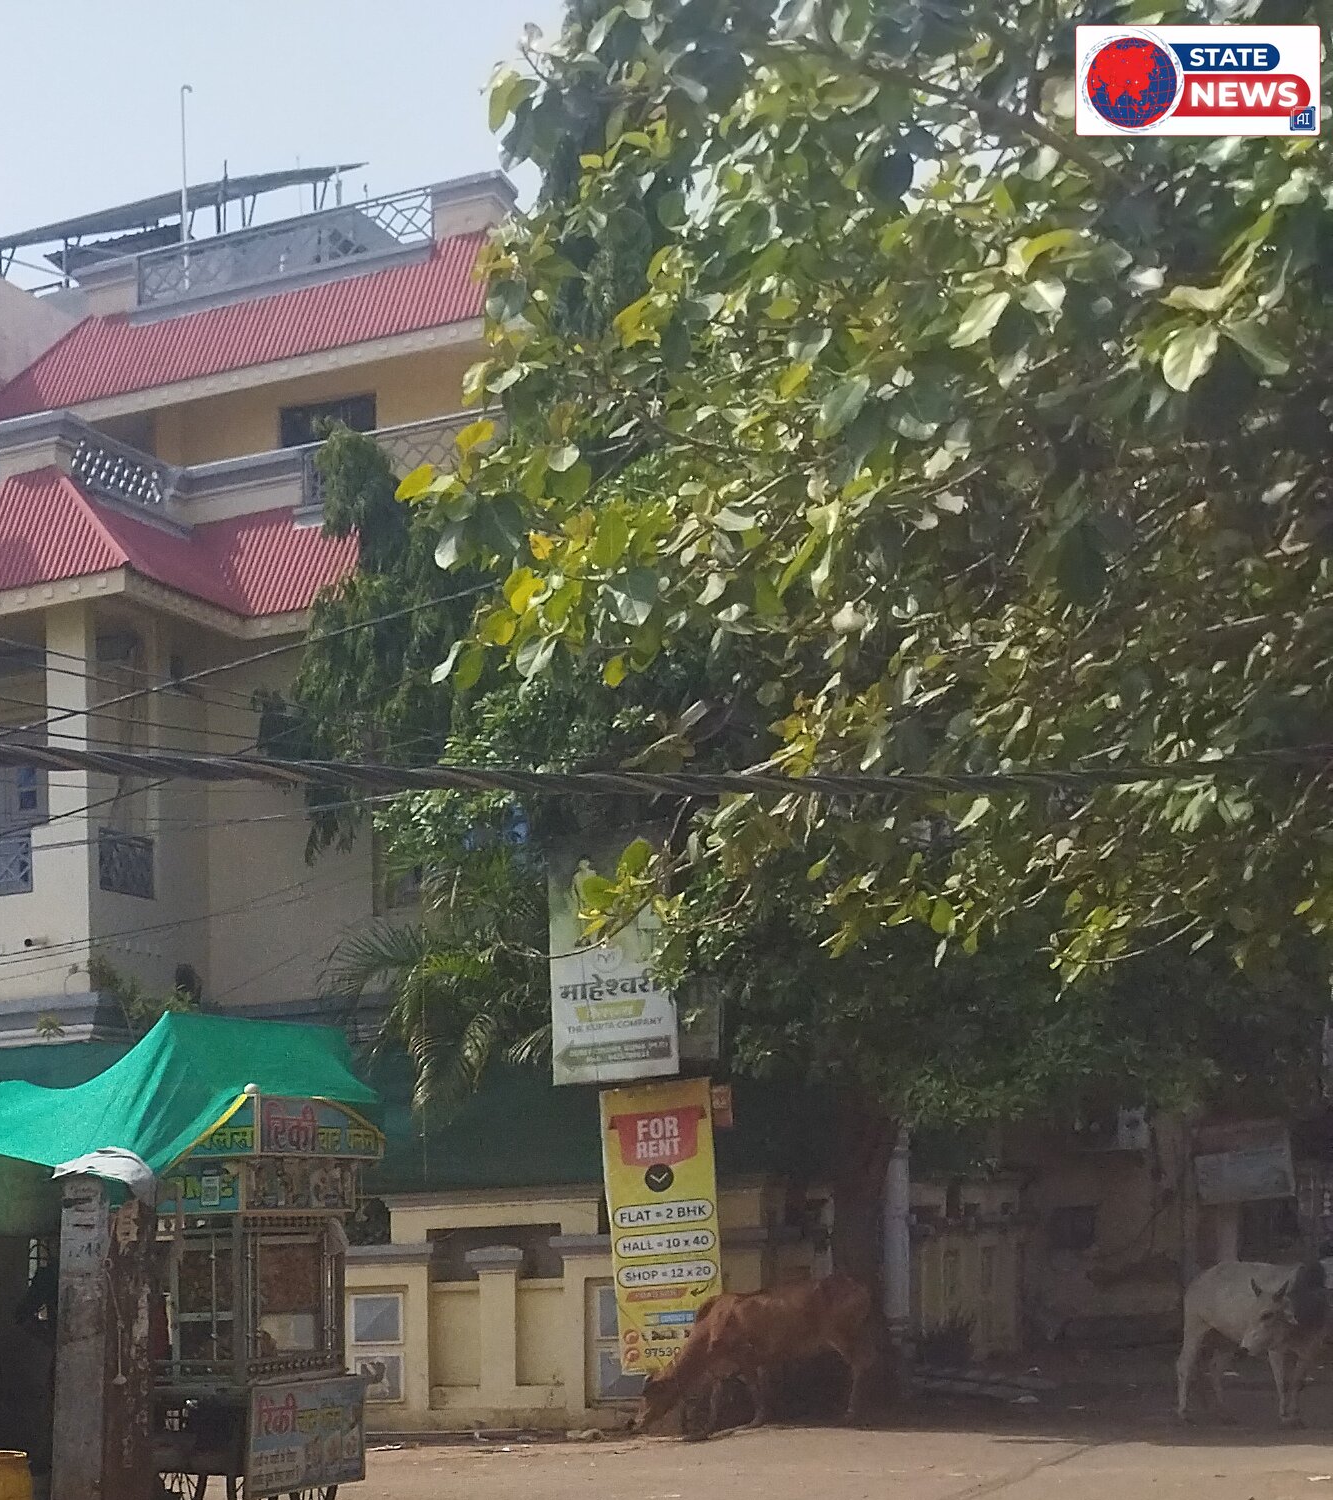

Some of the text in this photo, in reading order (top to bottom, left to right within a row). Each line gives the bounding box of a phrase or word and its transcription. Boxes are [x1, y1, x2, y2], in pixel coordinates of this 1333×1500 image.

[636, 1115, 679, 1141] FOR
[636, 1136, 681, 1160] RENT
[620, 1209, 651, 1224] FLAT
[666, 1208, 673, 1219] 2
[677, 1204, 707, 1218] BHK
[622, 1242, 654, 1253] HALL
[666, 1238, 680, 1249] 10
[693, 1235, 709, 1245] 40
[624, 1270, 659, 1282] SHOP
[671, 1268, 684, 1278] 12
[695, 1265, 711, 1276] 20
